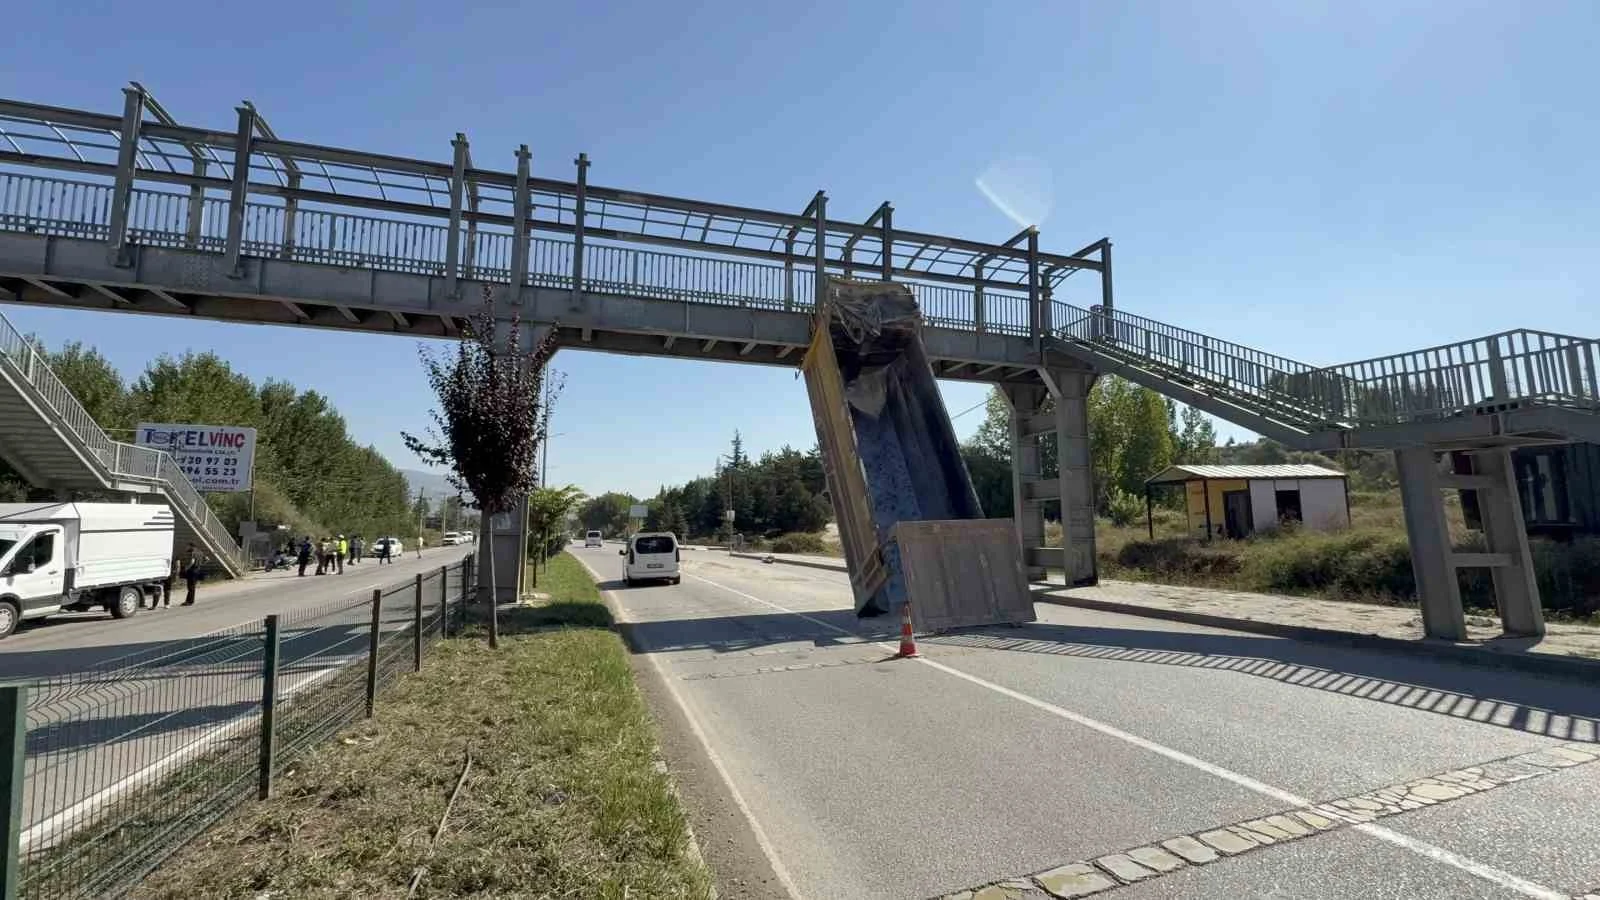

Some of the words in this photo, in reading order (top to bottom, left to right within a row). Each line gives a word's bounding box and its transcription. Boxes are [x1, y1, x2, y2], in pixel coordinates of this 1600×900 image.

[206, 457, 219, 465] 97
[205, 467, 218, 475] 55
[224, 468, 236, 476] 23
